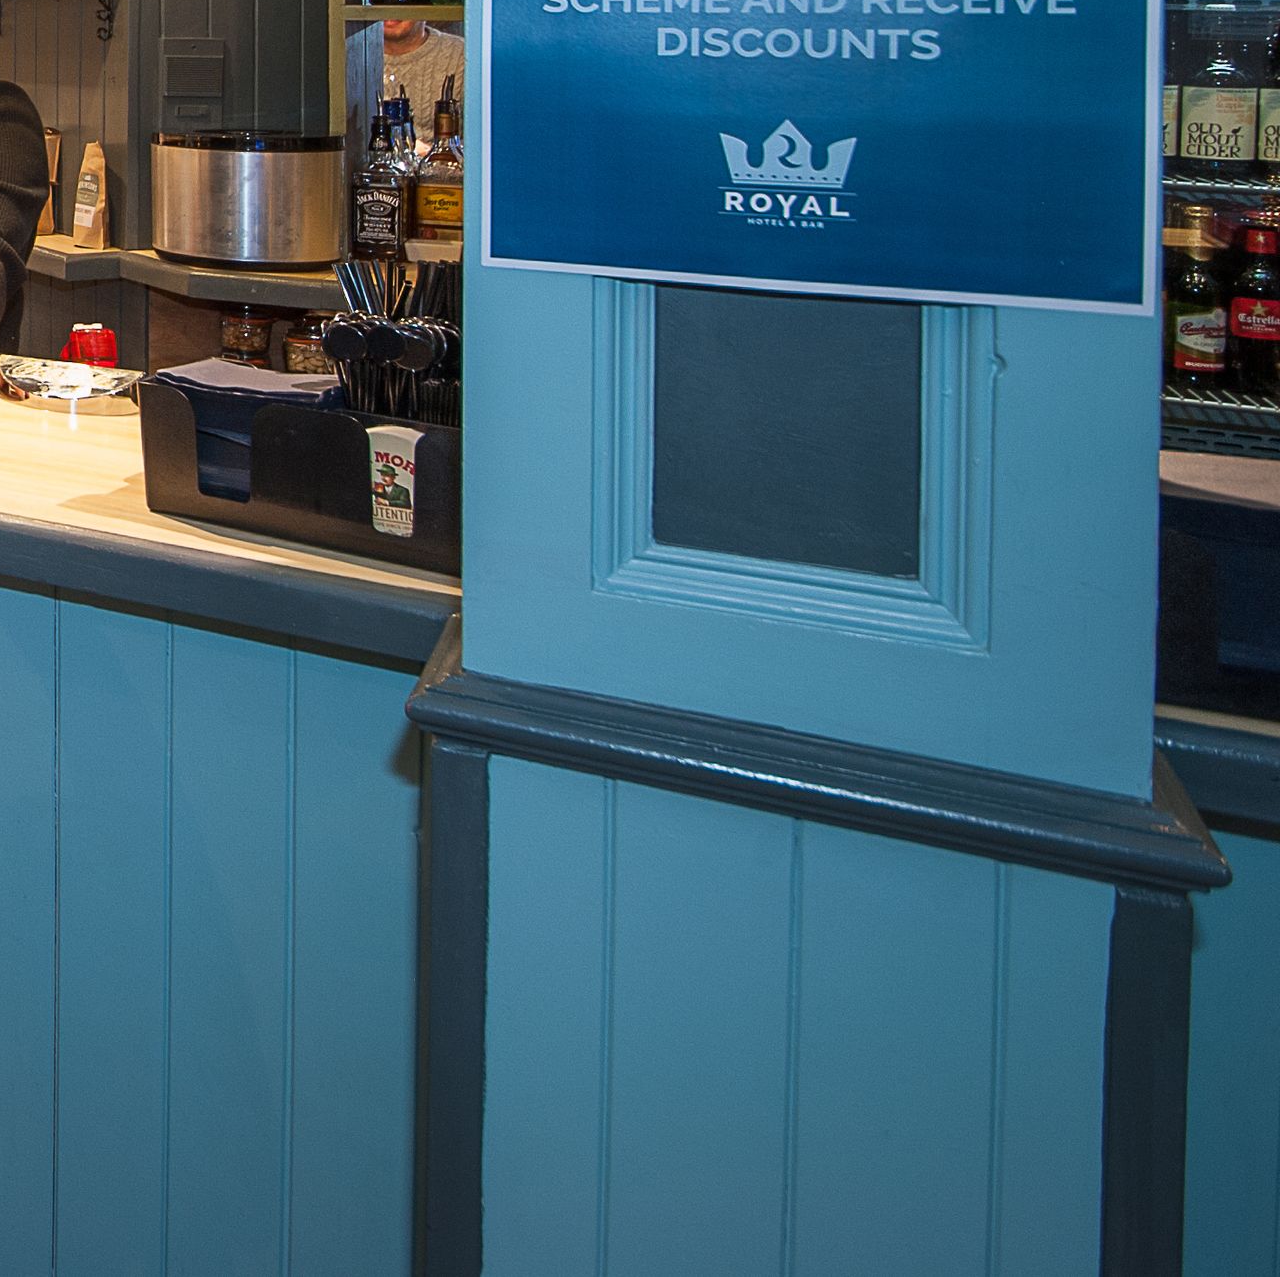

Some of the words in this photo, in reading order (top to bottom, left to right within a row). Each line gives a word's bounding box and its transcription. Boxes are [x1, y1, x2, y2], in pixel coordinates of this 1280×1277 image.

[656, 26, 942, 61] DISCOUNTS
[1187, 122, 1222, 135] OLD
[1187, 133, 1244, 146] MOUT
[1186, 144, 1242, 159] CIDER
[357, 193, 373, 206] JACK
[724, 191, 850, 220] ROYAL
